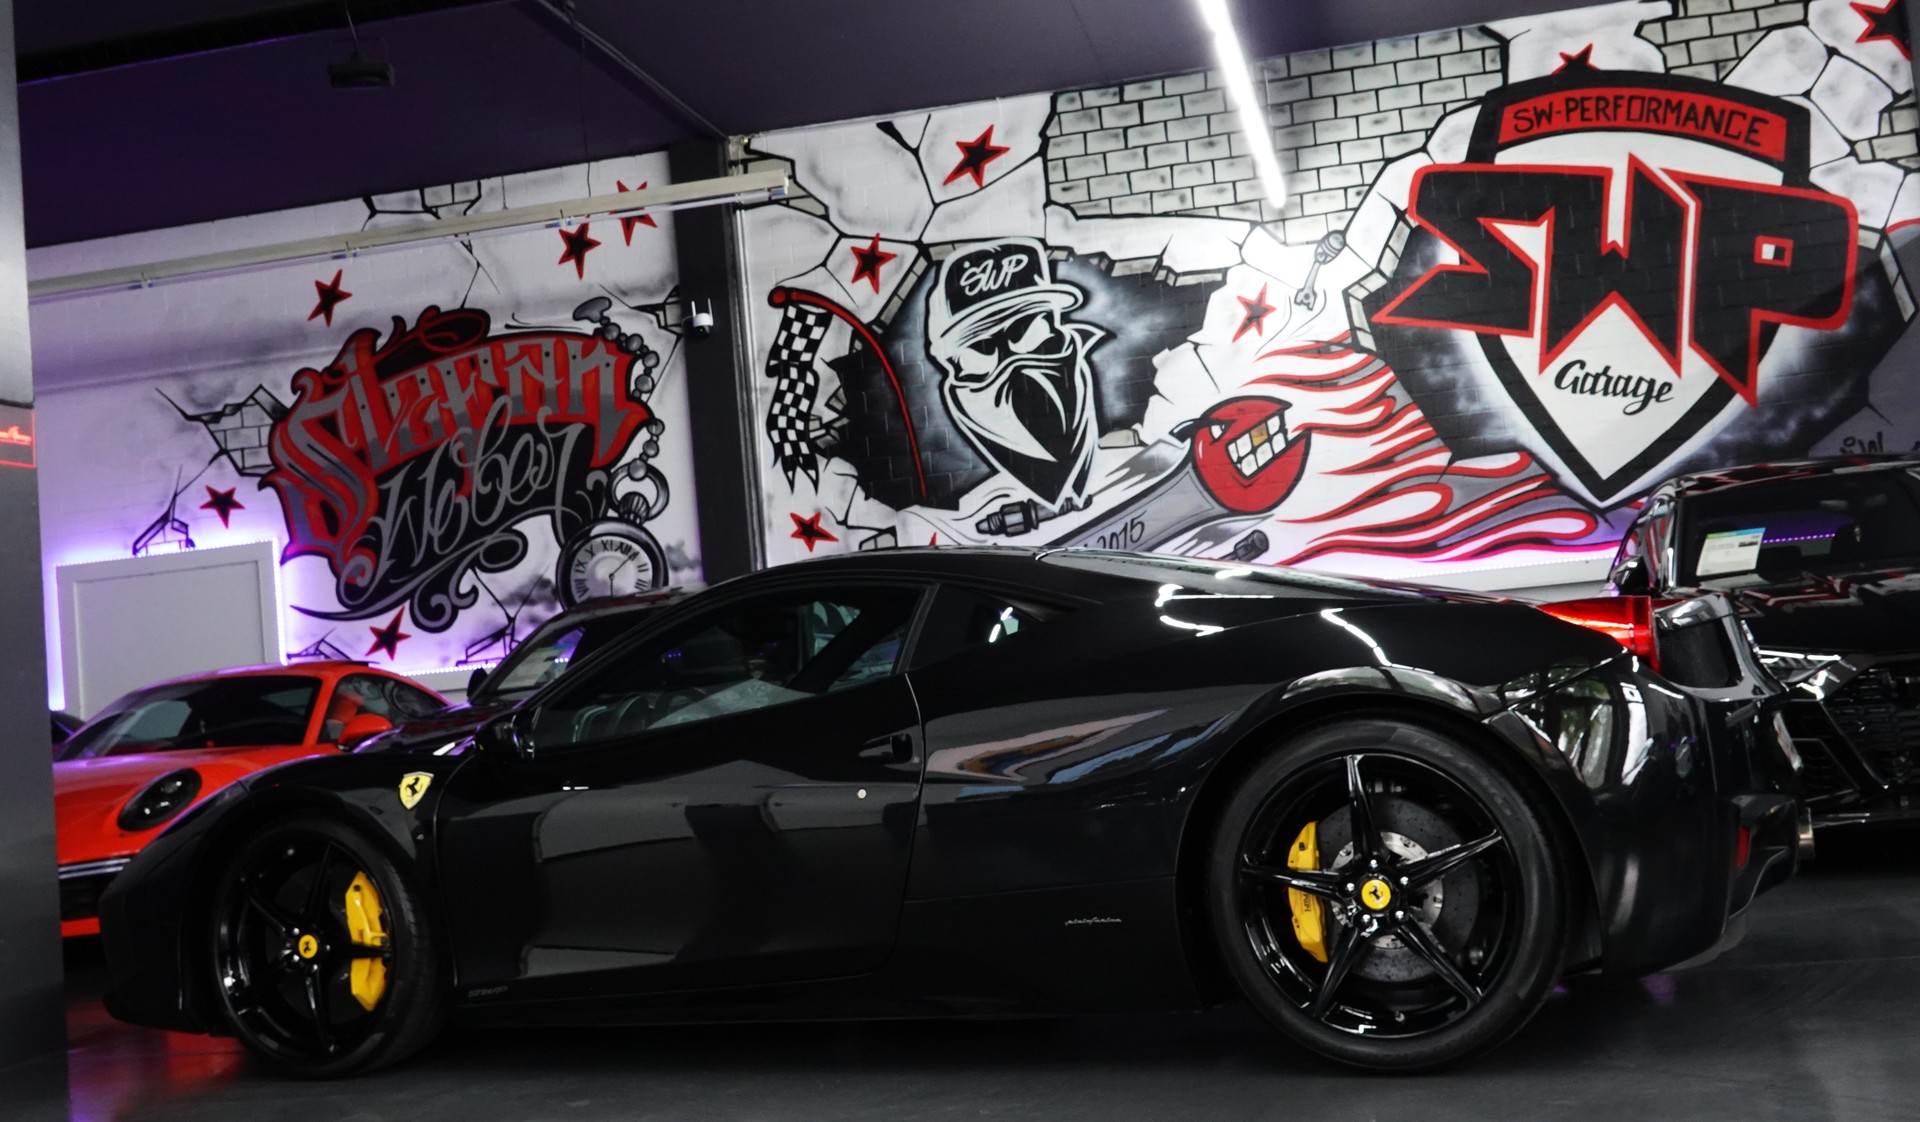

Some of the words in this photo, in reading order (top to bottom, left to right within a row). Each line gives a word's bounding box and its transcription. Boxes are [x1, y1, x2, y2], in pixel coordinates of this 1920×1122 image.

[1512, 94, 1769, 148] SW-PERFORMANCE
[960, 253, 1029, 297] SWP
[1371, 152, 1859, 408] SWP
[1554, 359, 1674, 416] Garage
